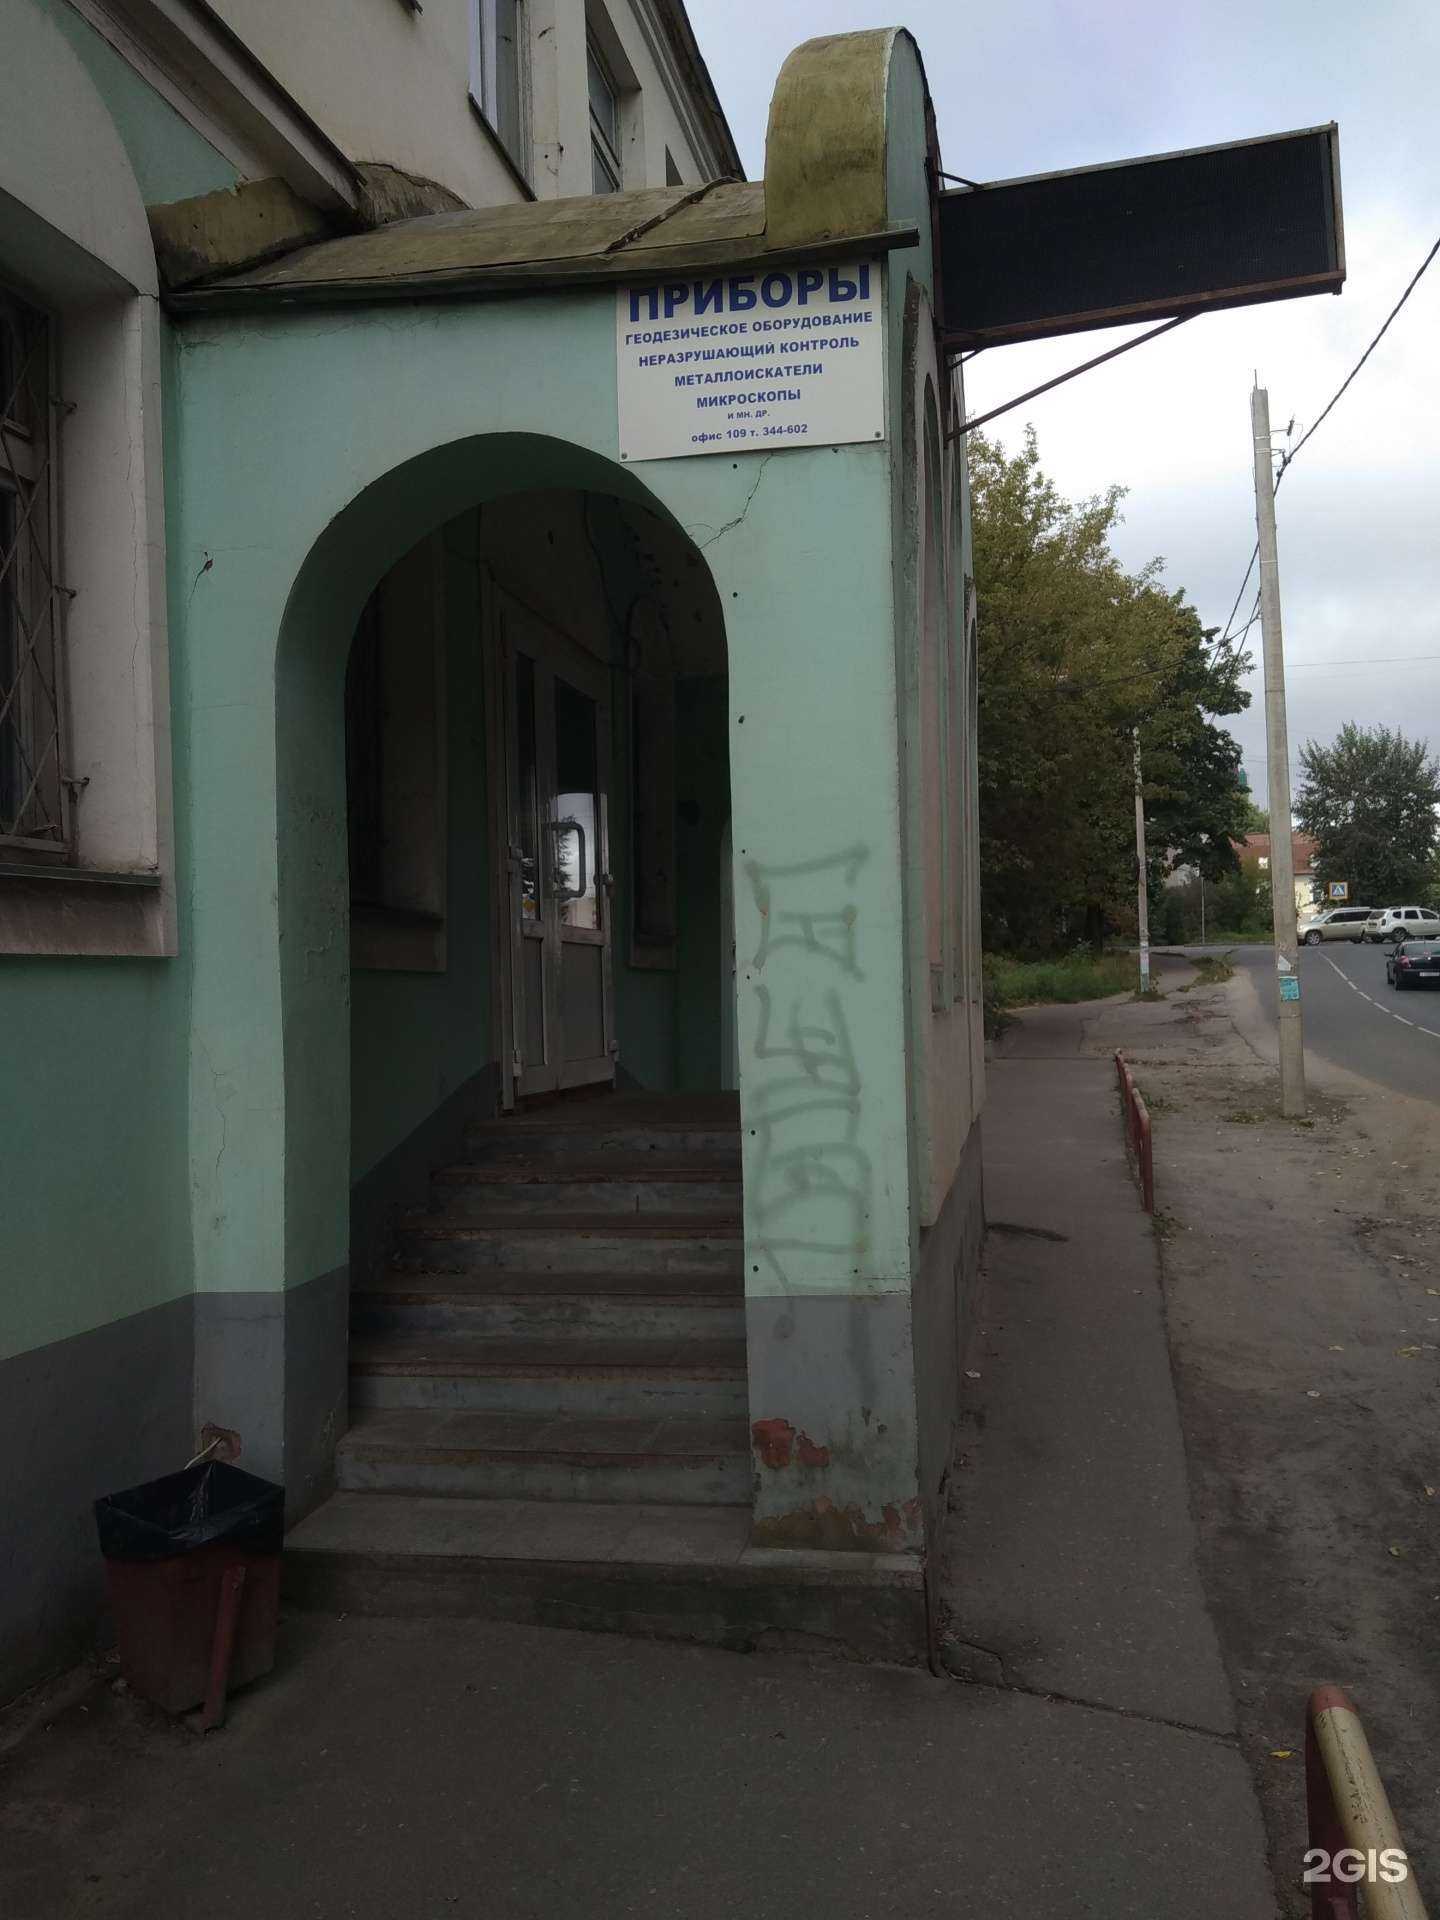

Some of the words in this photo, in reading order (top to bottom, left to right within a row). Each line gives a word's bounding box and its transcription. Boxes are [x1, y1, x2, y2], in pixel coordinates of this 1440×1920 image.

[629, 264, 871, 323] ПРИБОРЫ
[625, 322, 748, 345] ГЕОДЕЗИЧЕСКОЕ
[752, 311, 873, 332] ОБОРУДОВАНИЕ
[639, 341, 776, 367] НЕРАЗРУШАЮЩИЙ
[780, 336, 860, 354] КОНТРОЛЬ
[674, 363, 823, 387] МЕТАЛЛОИСКАТЕЛИ
[696, 388, 801, 408] МИКРОСКОПЫ
[727, 412, 734, 420] И
[736, 411, 753, 419] МН.
[755, 409, 770, 419] ДР.
[691, 431, 723, 443] офис
[726, 428, 747, 439] 109
[750, 430, 759, 438] т.
[762, 424, 808, 437] 344-602
